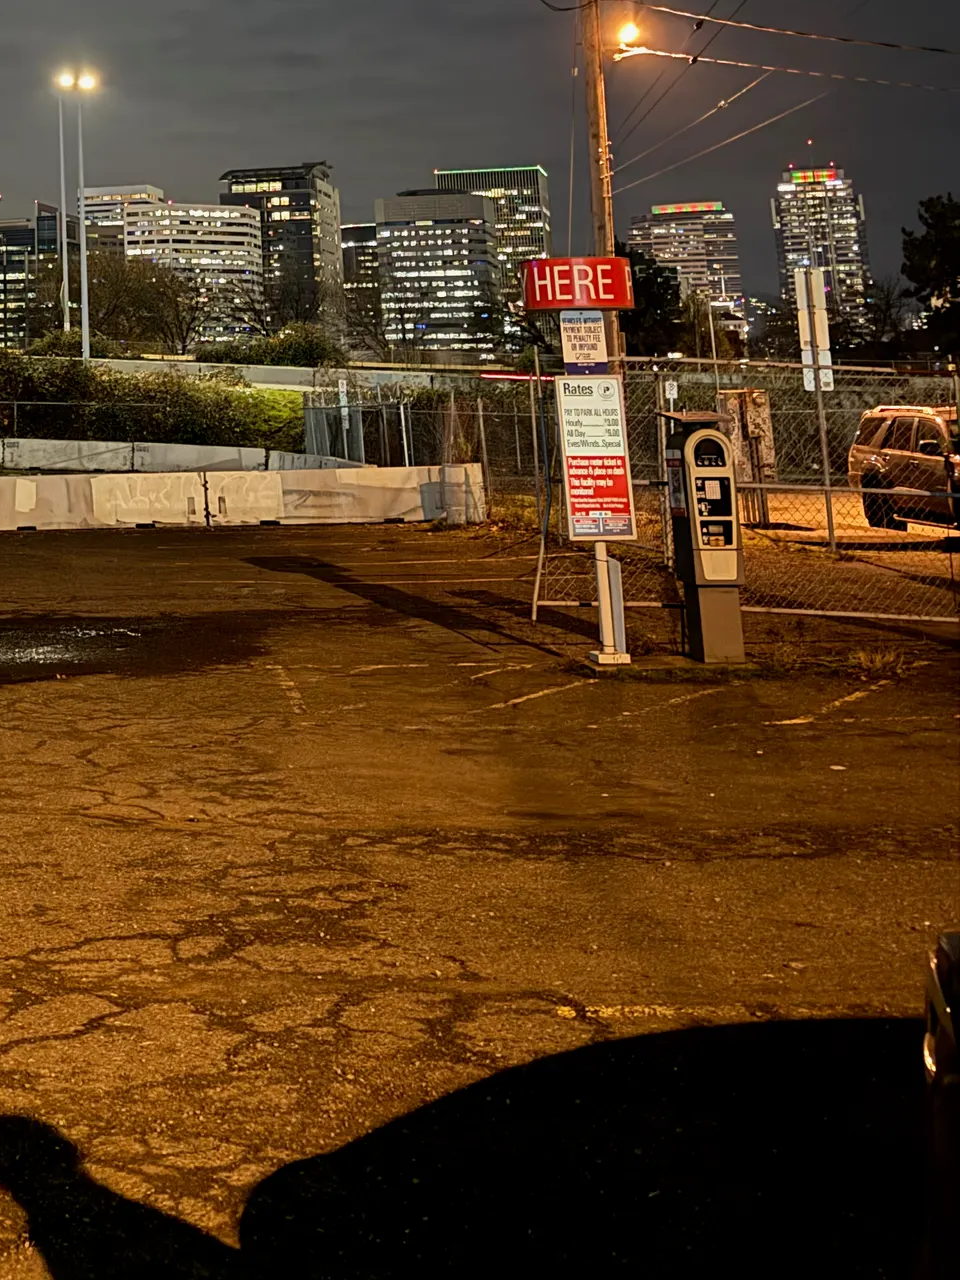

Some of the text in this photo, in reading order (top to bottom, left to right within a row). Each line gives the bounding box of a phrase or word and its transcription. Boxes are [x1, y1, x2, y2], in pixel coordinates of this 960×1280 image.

[533, 264, 615, 301] HERE
[562, 325, 603, 334] PAYMENT SUBJECT
[566, 334, 601, 342] TO PENALTY FEE
[570, 343, 598, 351] OR IMPOUND
[563, 382, 594, 395] Rates
[564, 408, 619, 417] PAY TO PARK ALL HOURS
[566, 429, 574, 437] All
[574, 429, 586, 438] Day
